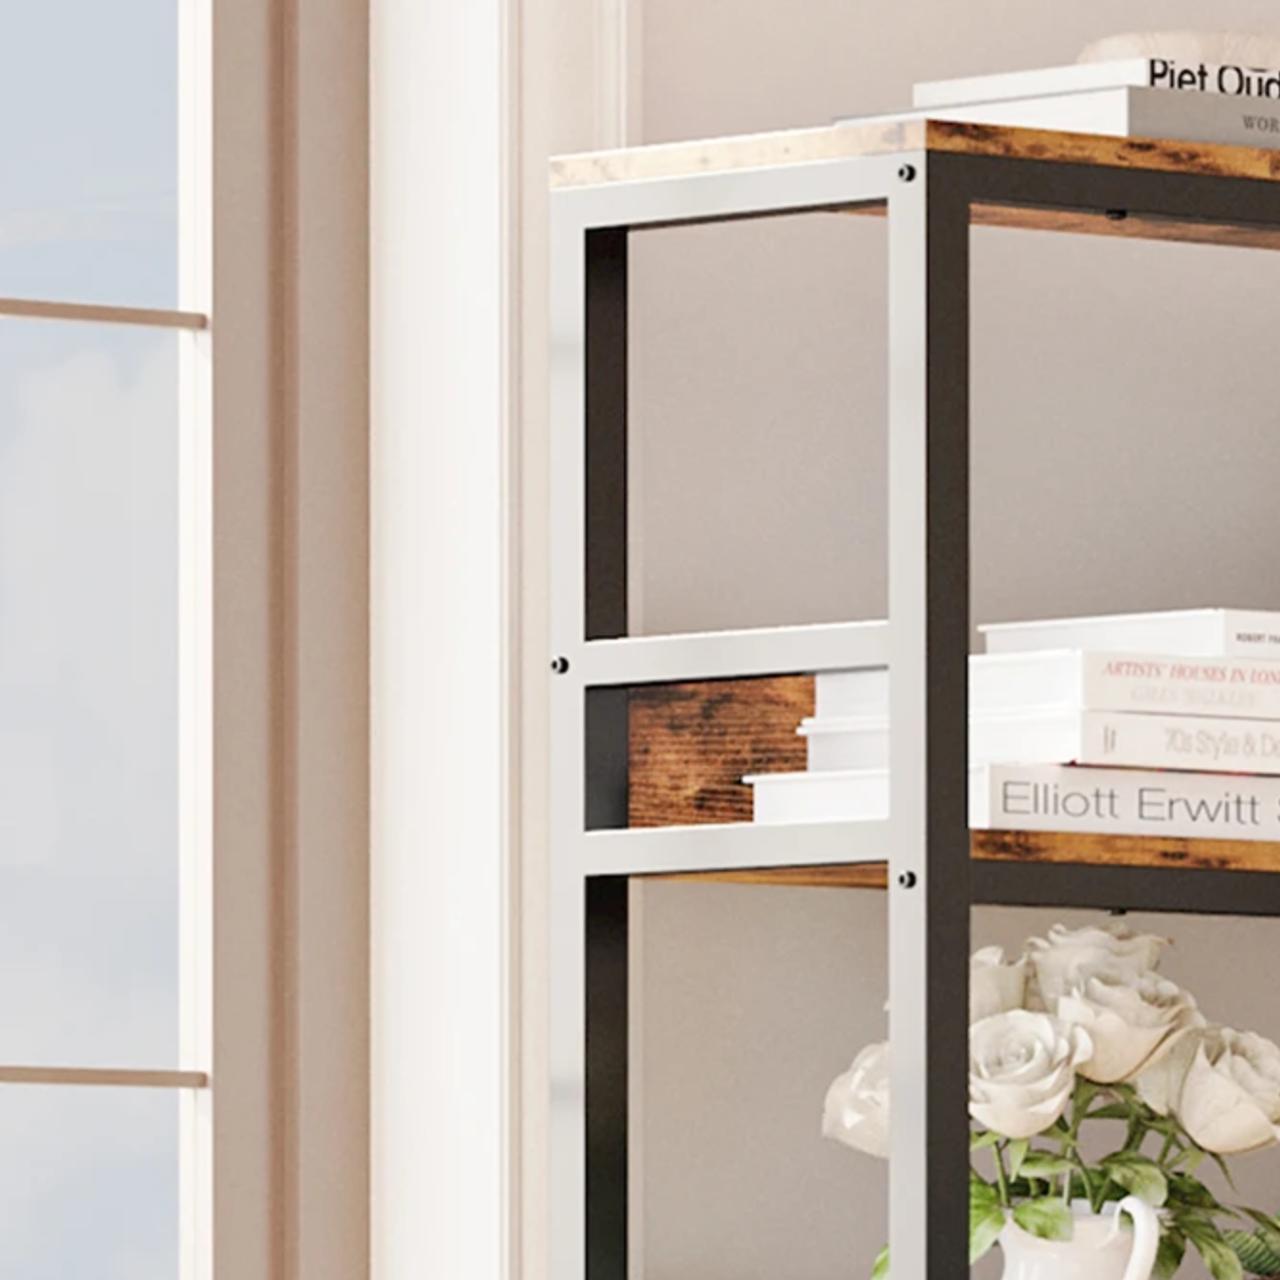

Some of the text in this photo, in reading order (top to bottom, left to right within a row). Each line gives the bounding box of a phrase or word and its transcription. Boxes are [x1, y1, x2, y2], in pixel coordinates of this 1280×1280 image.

[1170, 663, 1226, 683] HOUSES
[1230, 665, 1245, 682] IN
[1001, 780, 1120, 821] Elliott
[1139, 787, 1261, 826] Erwitt
